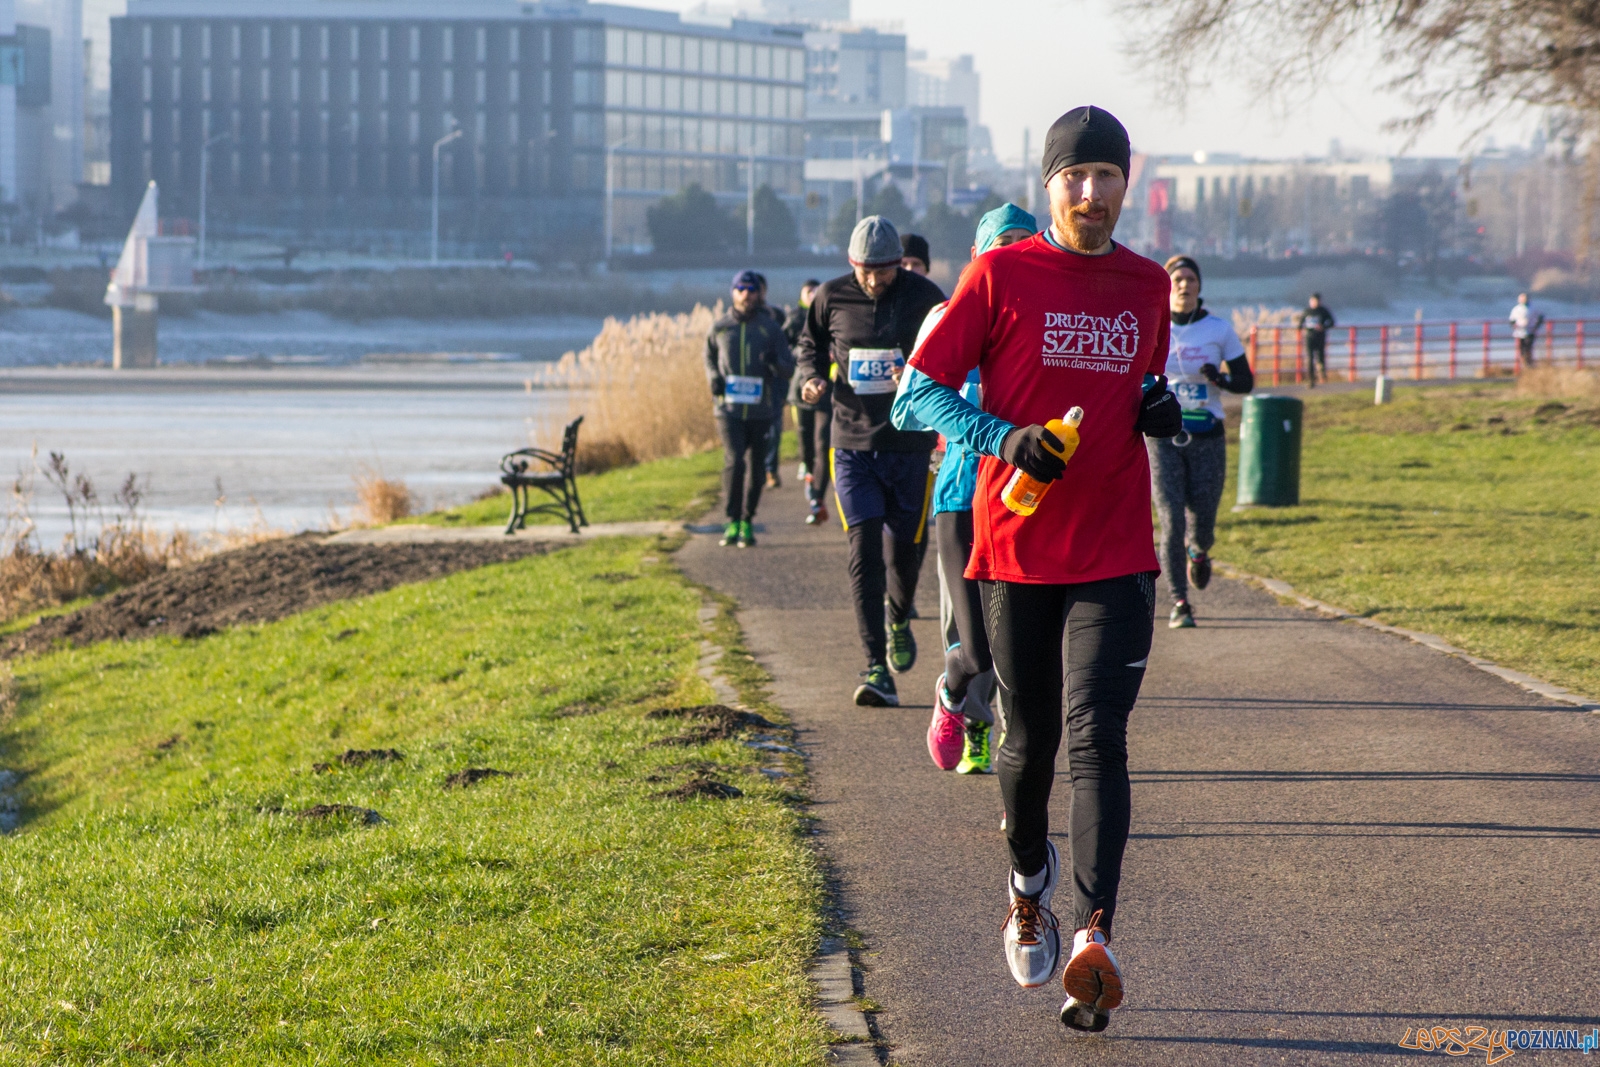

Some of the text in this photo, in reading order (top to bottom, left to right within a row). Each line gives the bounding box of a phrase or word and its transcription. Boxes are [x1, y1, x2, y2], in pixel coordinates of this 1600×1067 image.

[1044, 311, 1124, 333] DRUŻYNA
[1042, 330, 1140, 358] SZPIKU
[858, 360, 896, 377] 482
[1042, 357, 1131, 374] www.darszpiku.pl
